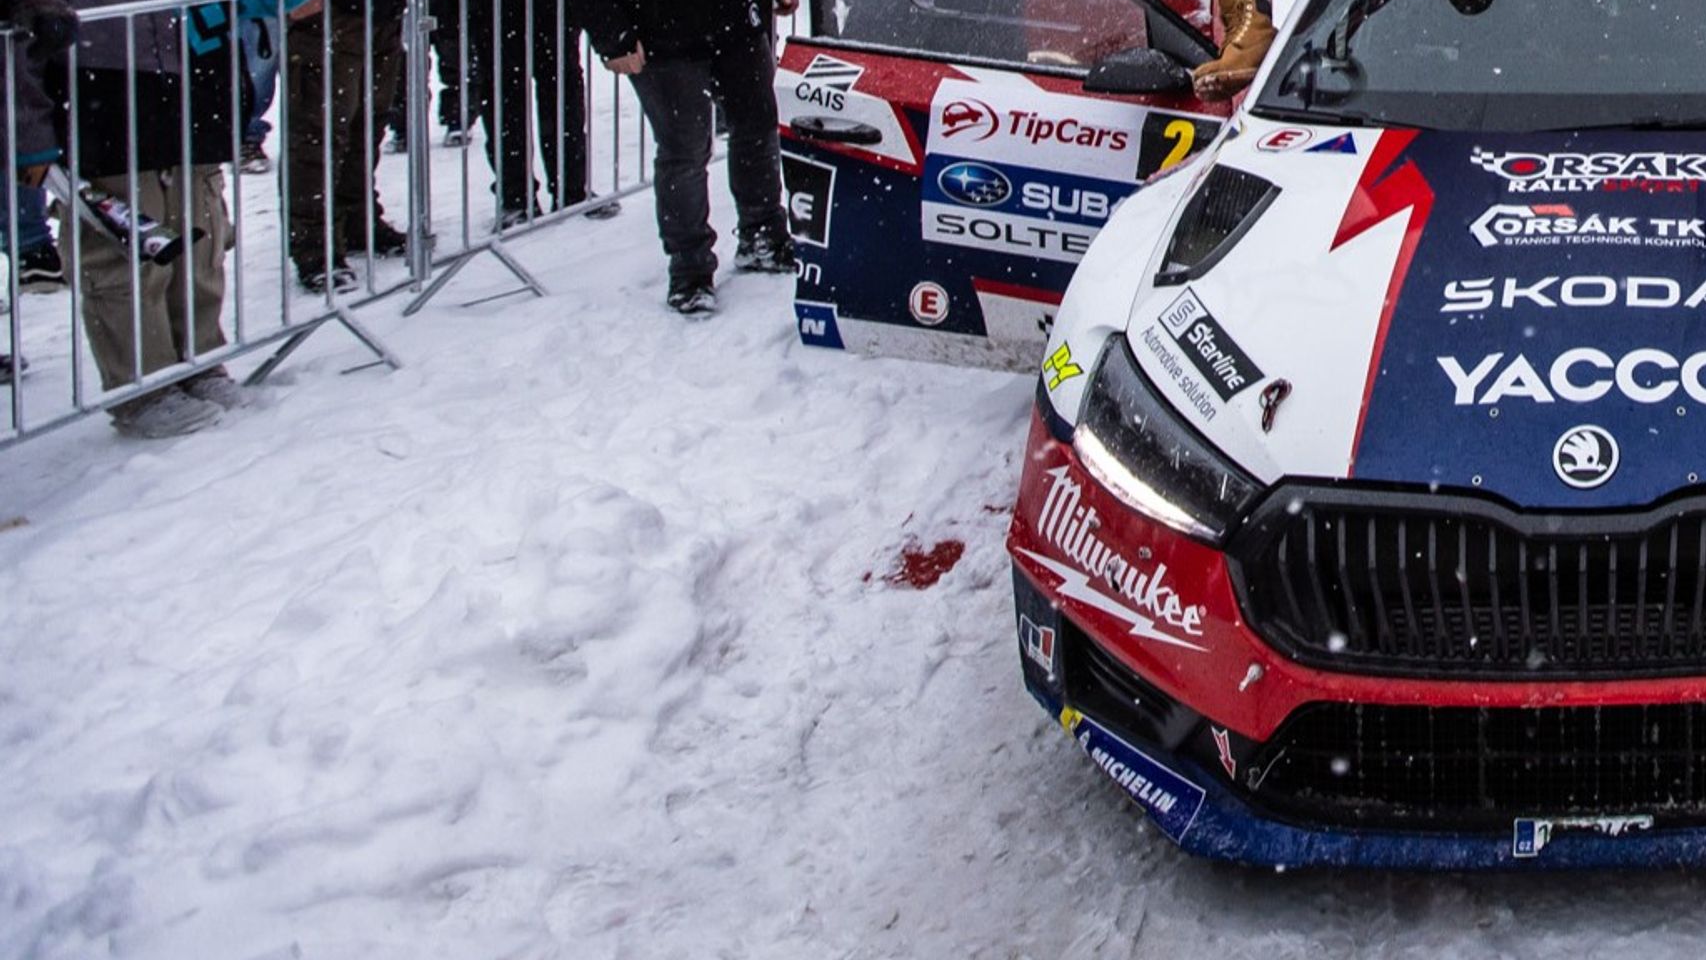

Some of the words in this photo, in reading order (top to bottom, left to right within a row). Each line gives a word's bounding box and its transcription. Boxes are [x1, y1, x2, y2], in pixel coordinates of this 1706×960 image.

[795, 82, 845, 112] CAIS
[1008, 111, 1128, 151] TipCars
[1160, 119, 1196, 171] 2
[1265, 130, 1303, 147] E
[936, 213, 1091, 254] SOLTE
[1504, 236, 1560, 246] STANICE
[1650, 218, 1706, 238] TK
[920, 290, 938, 315] E
[1140, 325, 1183, 379] Automotive
[1178, 376, 1217, 423] solution
[1186, 320, 1246, 391] Starline
[1037, 464, 1204, 635] Milwaukee
[1093, 746, 1177, 814] MICHELIN
